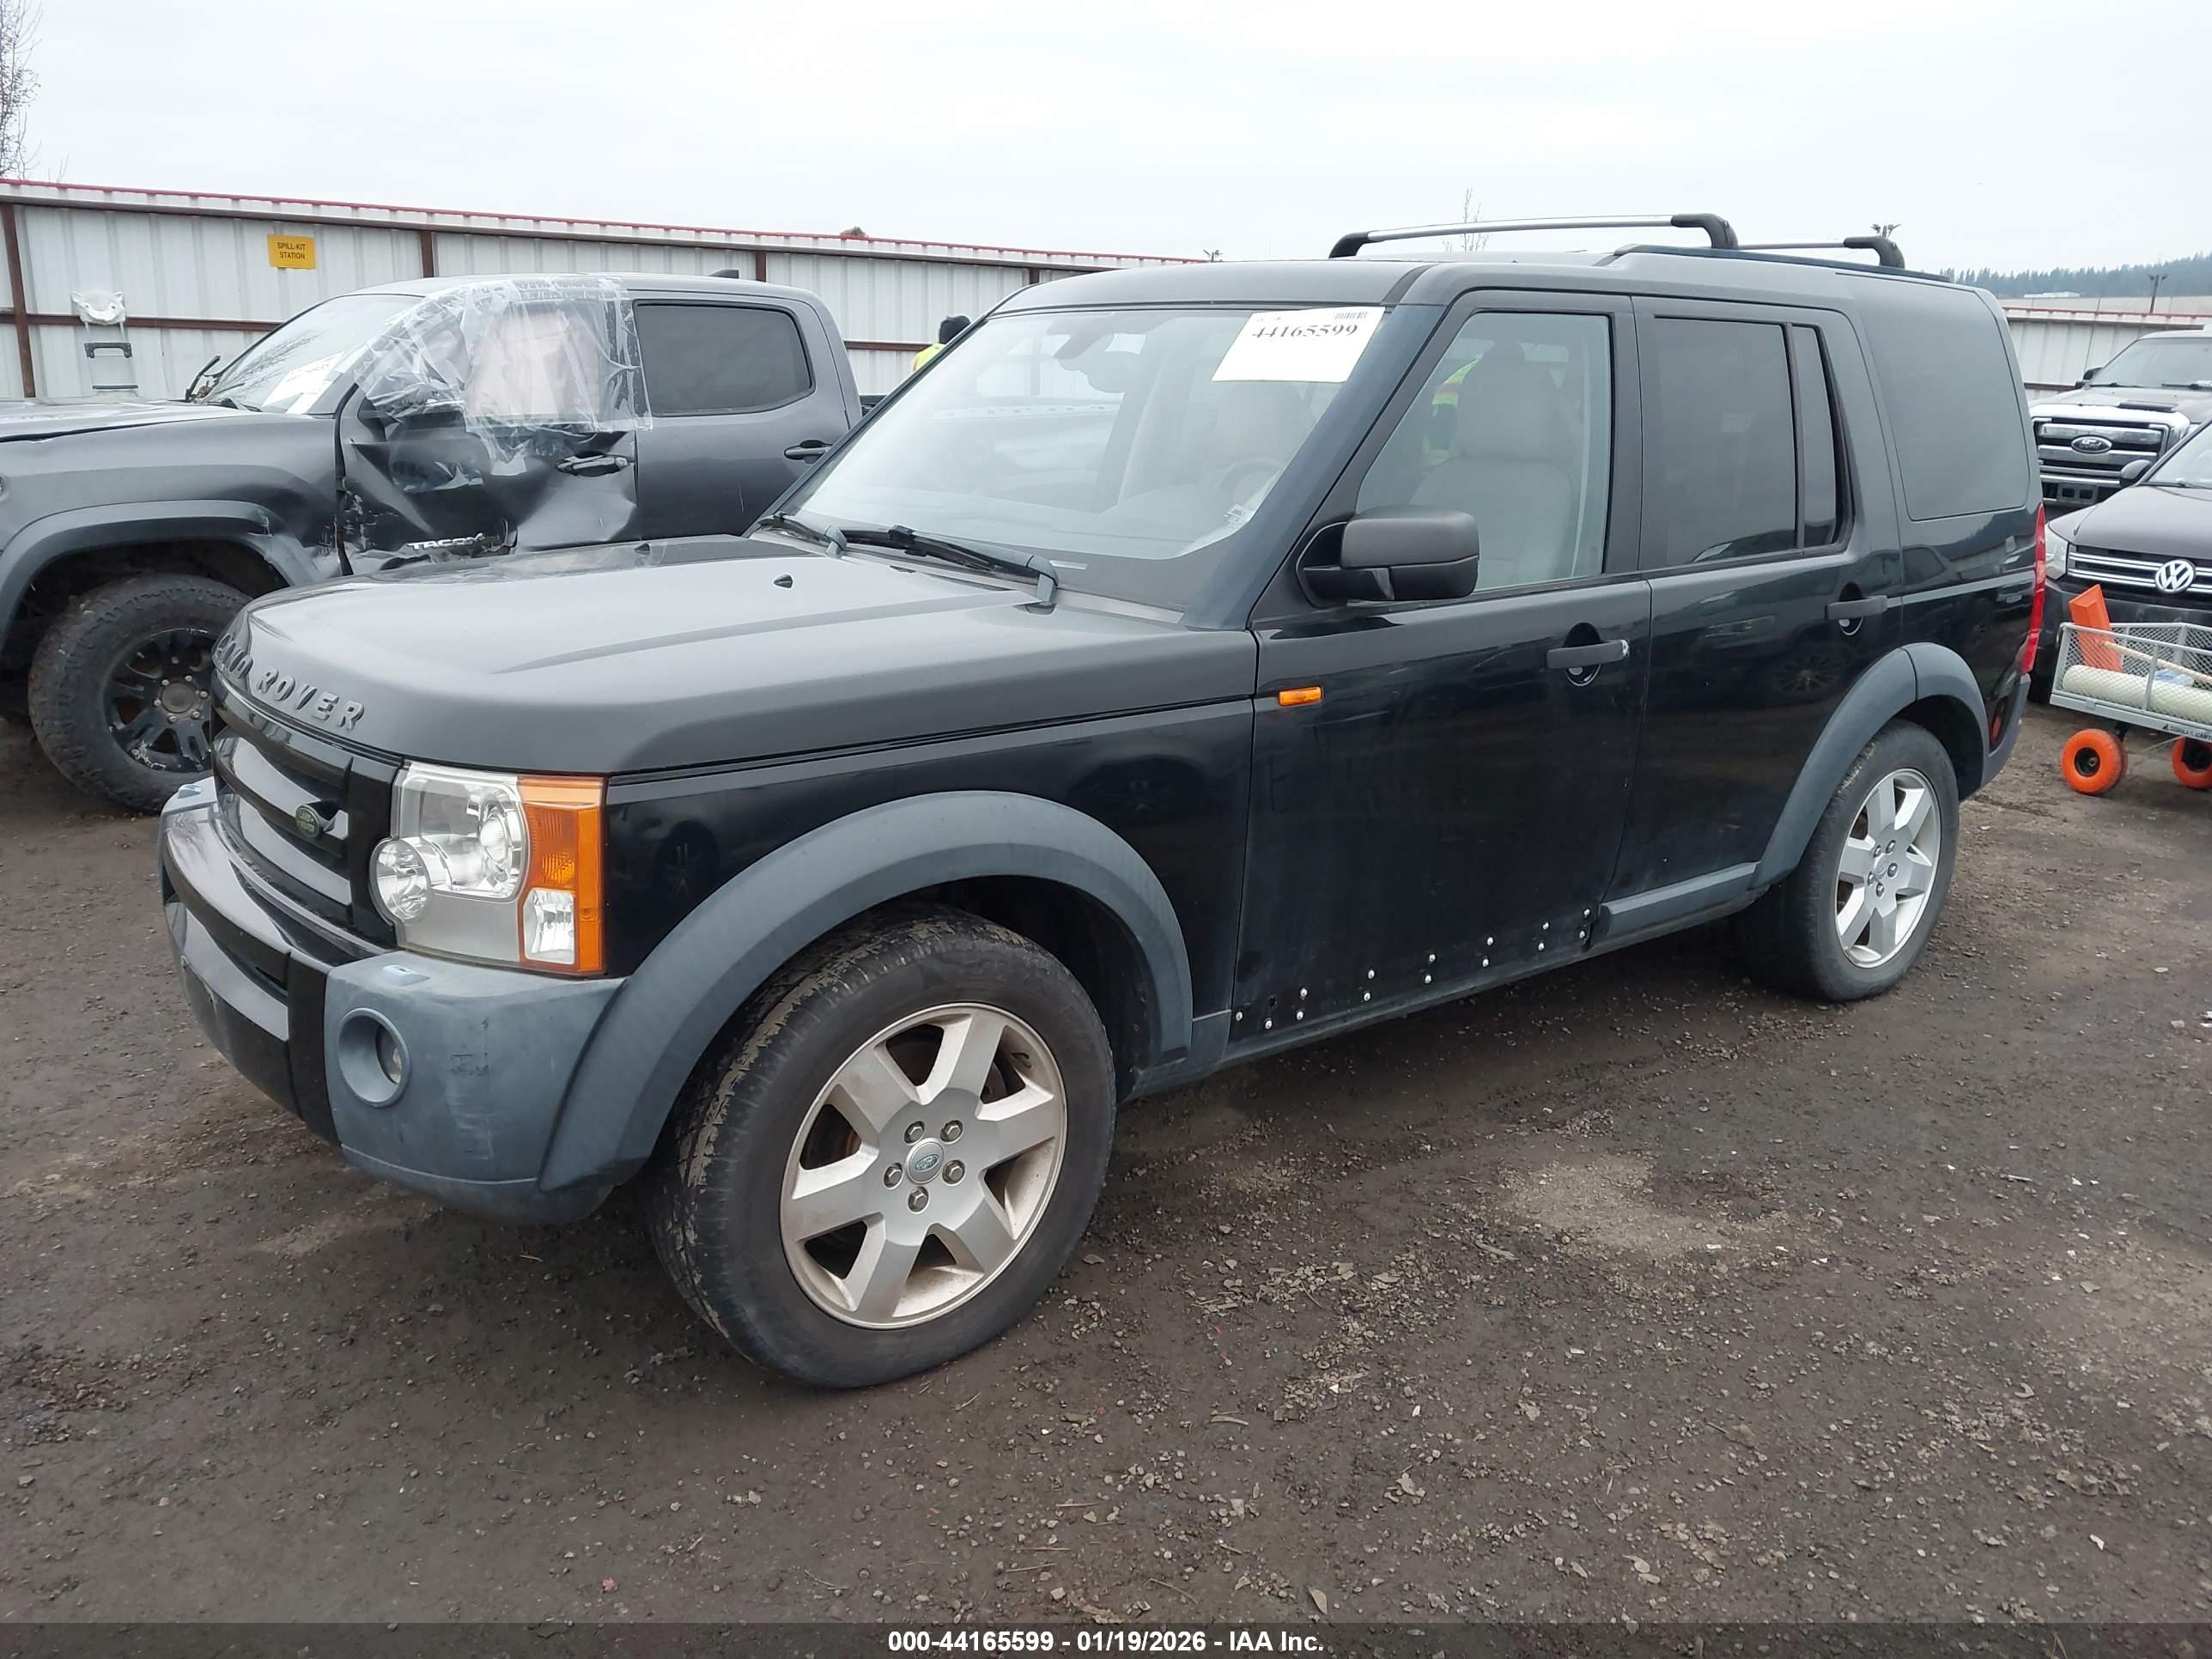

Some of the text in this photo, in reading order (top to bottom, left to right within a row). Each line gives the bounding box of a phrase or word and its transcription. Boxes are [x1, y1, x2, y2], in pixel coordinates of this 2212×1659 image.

[276, 241, 295, 250] SPILL
[279, 251, 305, 259] STATION
[1251, 323, 1358, 338] 44165599
[258, 665, 365, 731] ROVER
